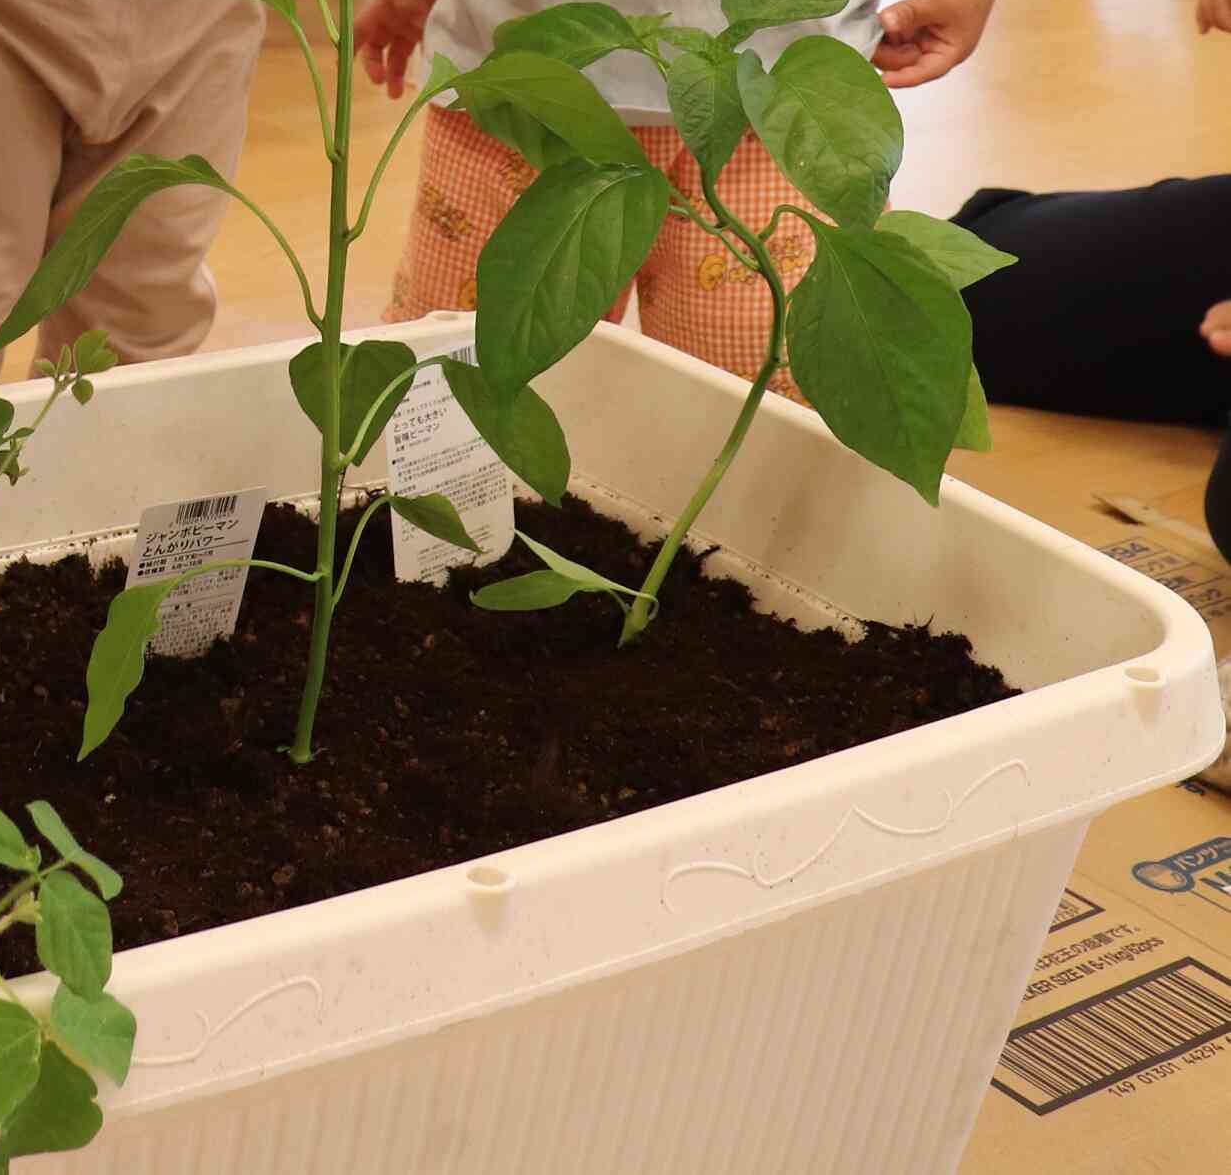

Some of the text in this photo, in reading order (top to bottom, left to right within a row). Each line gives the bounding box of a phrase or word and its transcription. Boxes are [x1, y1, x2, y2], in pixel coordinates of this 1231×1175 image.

[142, 536, 226, 558] とんがりパワー
